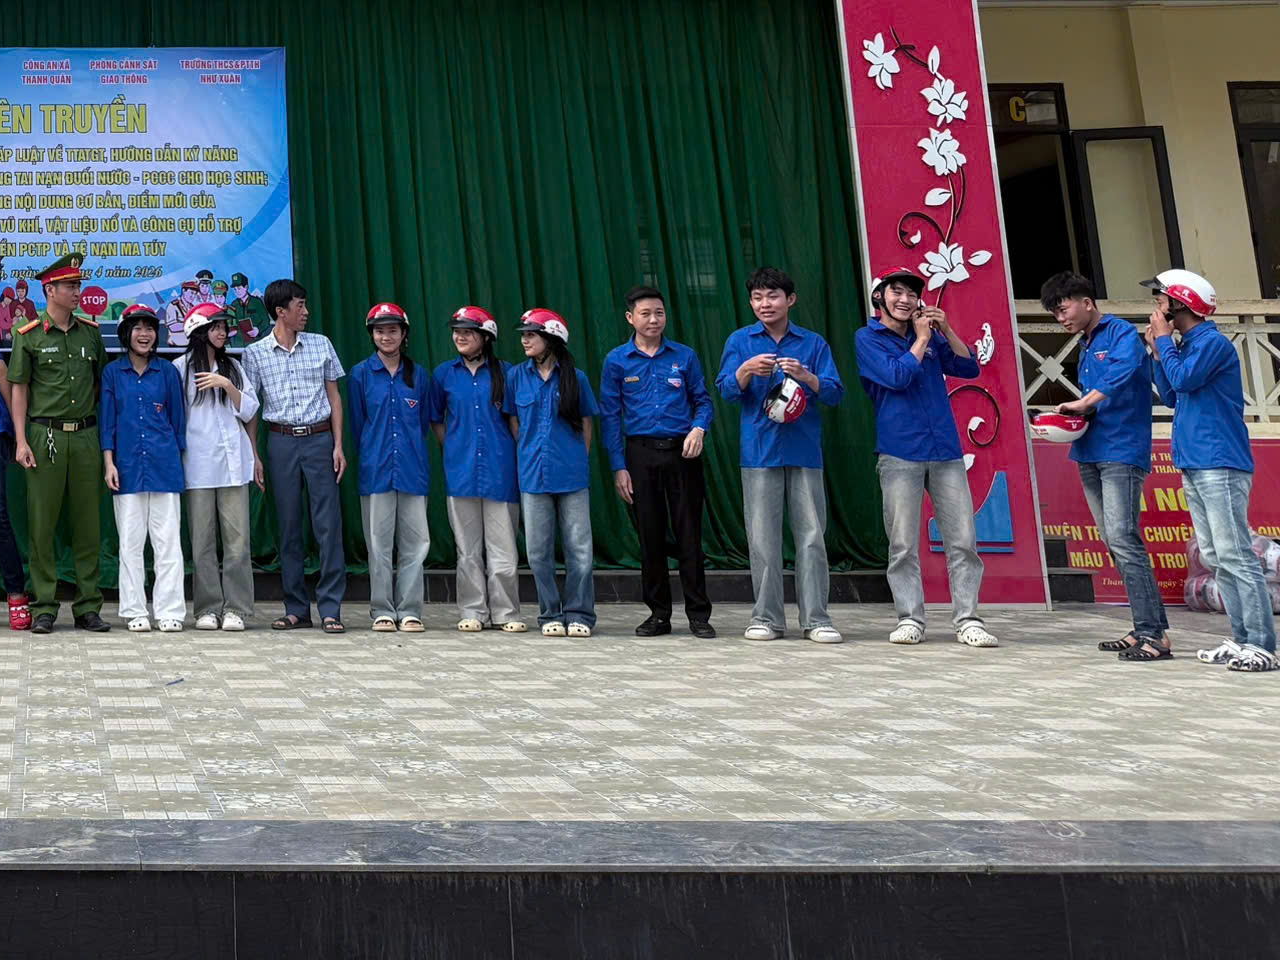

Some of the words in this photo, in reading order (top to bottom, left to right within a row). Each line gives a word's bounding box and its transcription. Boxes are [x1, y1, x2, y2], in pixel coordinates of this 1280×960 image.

[46, 61, 58, 70] AN
[213, 60, 261, 70] THCS&PTTH
[22, 75, 48, 85] THANH
[100, 74, 120, 84] GIAO
[120, 73, 148, 84] THÔNG
[200, 74, 217, 84] NHƯ
[1009, 96, 1025, 121] C
[15, 145, 45, 165] LUẬT
[65, 148, 108, 164] TTATGT,
[110, 145, 153, 162] HƯỚNG
[14, 172, 34, 186] TAI
[36, 172, 62, 188] NẠN
[142, 171, 175, 186] PCCC
[178, 171, 204, 186] CHO
[206, 171, 231, 188] HỌC
[234, 171, 269, 187] SINH;
[15, 192, 36, 212] NỘI
[38, 194, 73, 209] DUNG
[163, 192, 187, 208] MỚI
[190, 190, 216, 208] CỦA
[46, 215, 69, 235] VẬT
[71, 215, 98, 235] LIỆU
[121, 215, 139, 232] VÀ
[140, 215, 175, 232] CÔNG
[177, 218, 196, 235] CỤ
[218, 217, 243, 235] TRỢ
[19, 242, 51, 256] PCTP
[90, 241, 118, 259] NẠN
[120, 241, 141, 256] MA
[94, 266, 103, 277] 4
[105, 265, 131, 278] năm
[134, 266, 163, 278] 2026
[82, 296, 106, 305] STOP
[1153, 465, 1182, 473] THAN
[1043, 522, 1083, 541] UYÊN
[1102, 577, 1123, 586] Than
